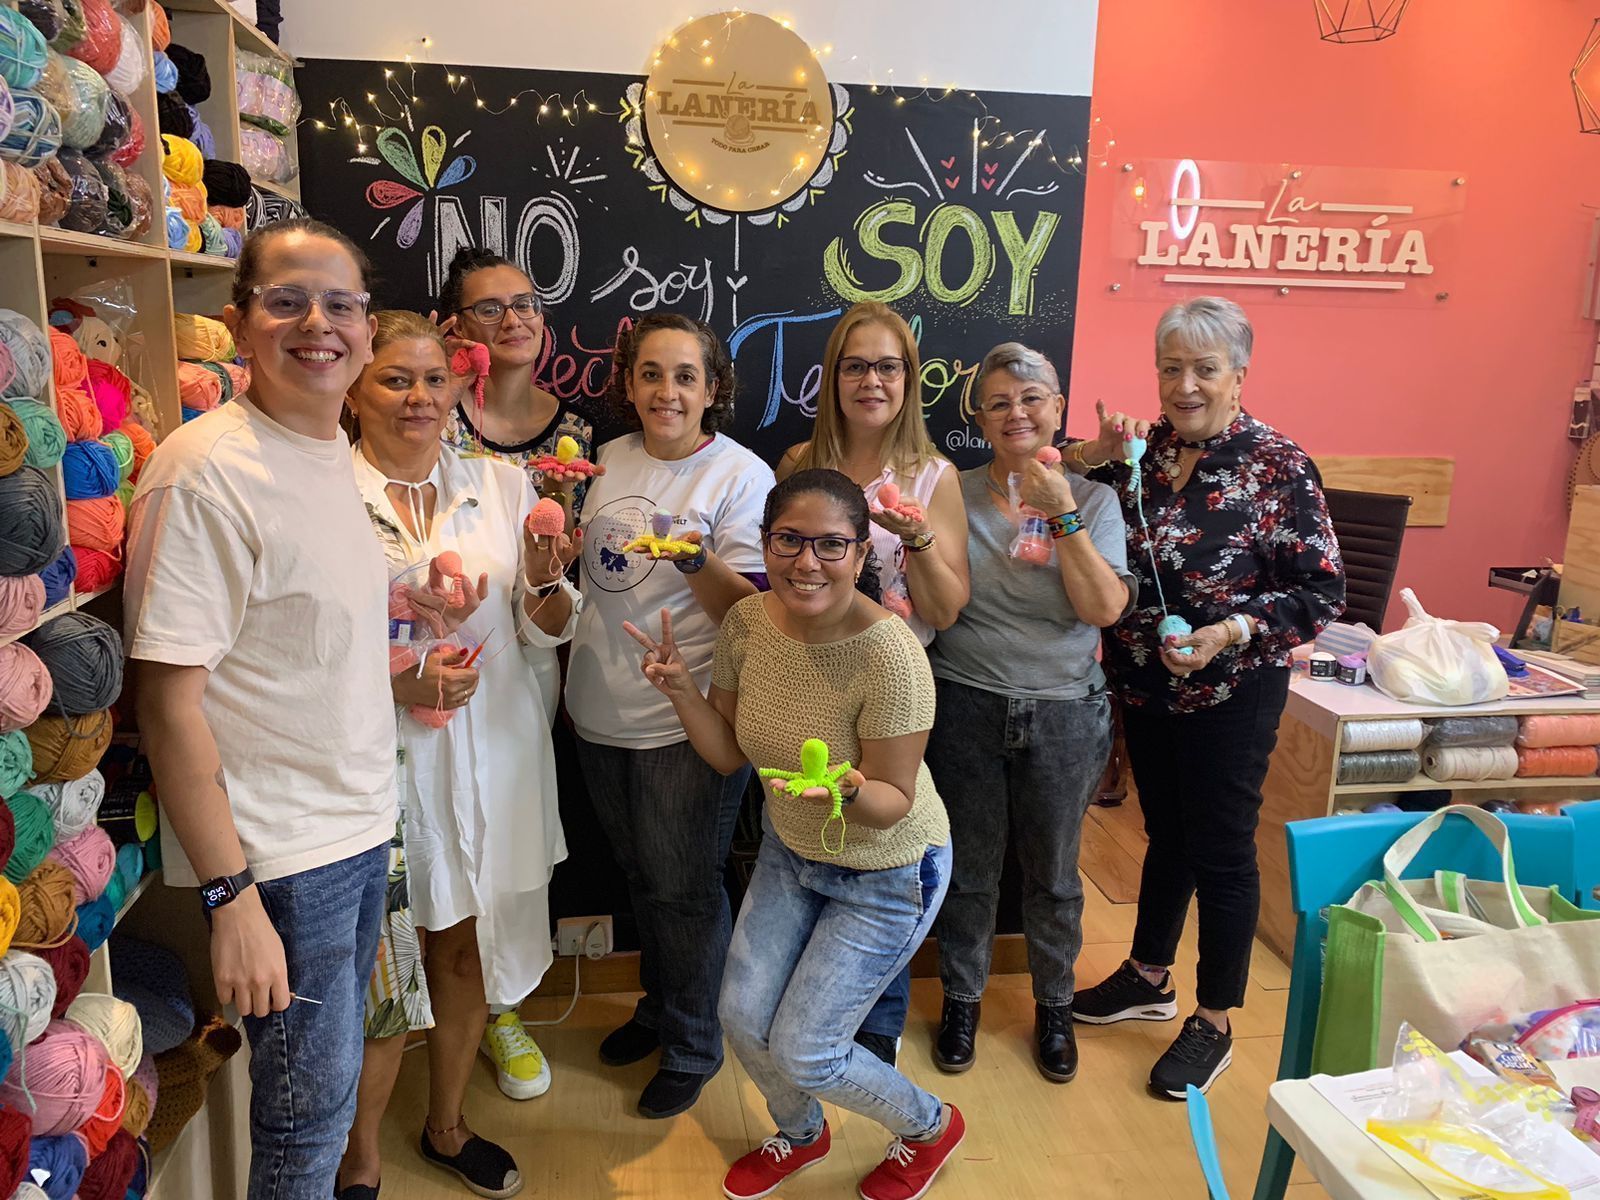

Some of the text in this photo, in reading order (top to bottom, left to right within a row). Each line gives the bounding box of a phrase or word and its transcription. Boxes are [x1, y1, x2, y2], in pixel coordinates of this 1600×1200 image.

[726, 71, 755, 96] La
[656, 90, 822, 126] LANERÍA
[711, 137, 728, 150] TODO
[1265, 178, 1322, 224] La
[433, 194, 580, 307] NO
[822, 199, 1059, 317] SOY
[1137, 214, 1434, 275] LANERÍA
